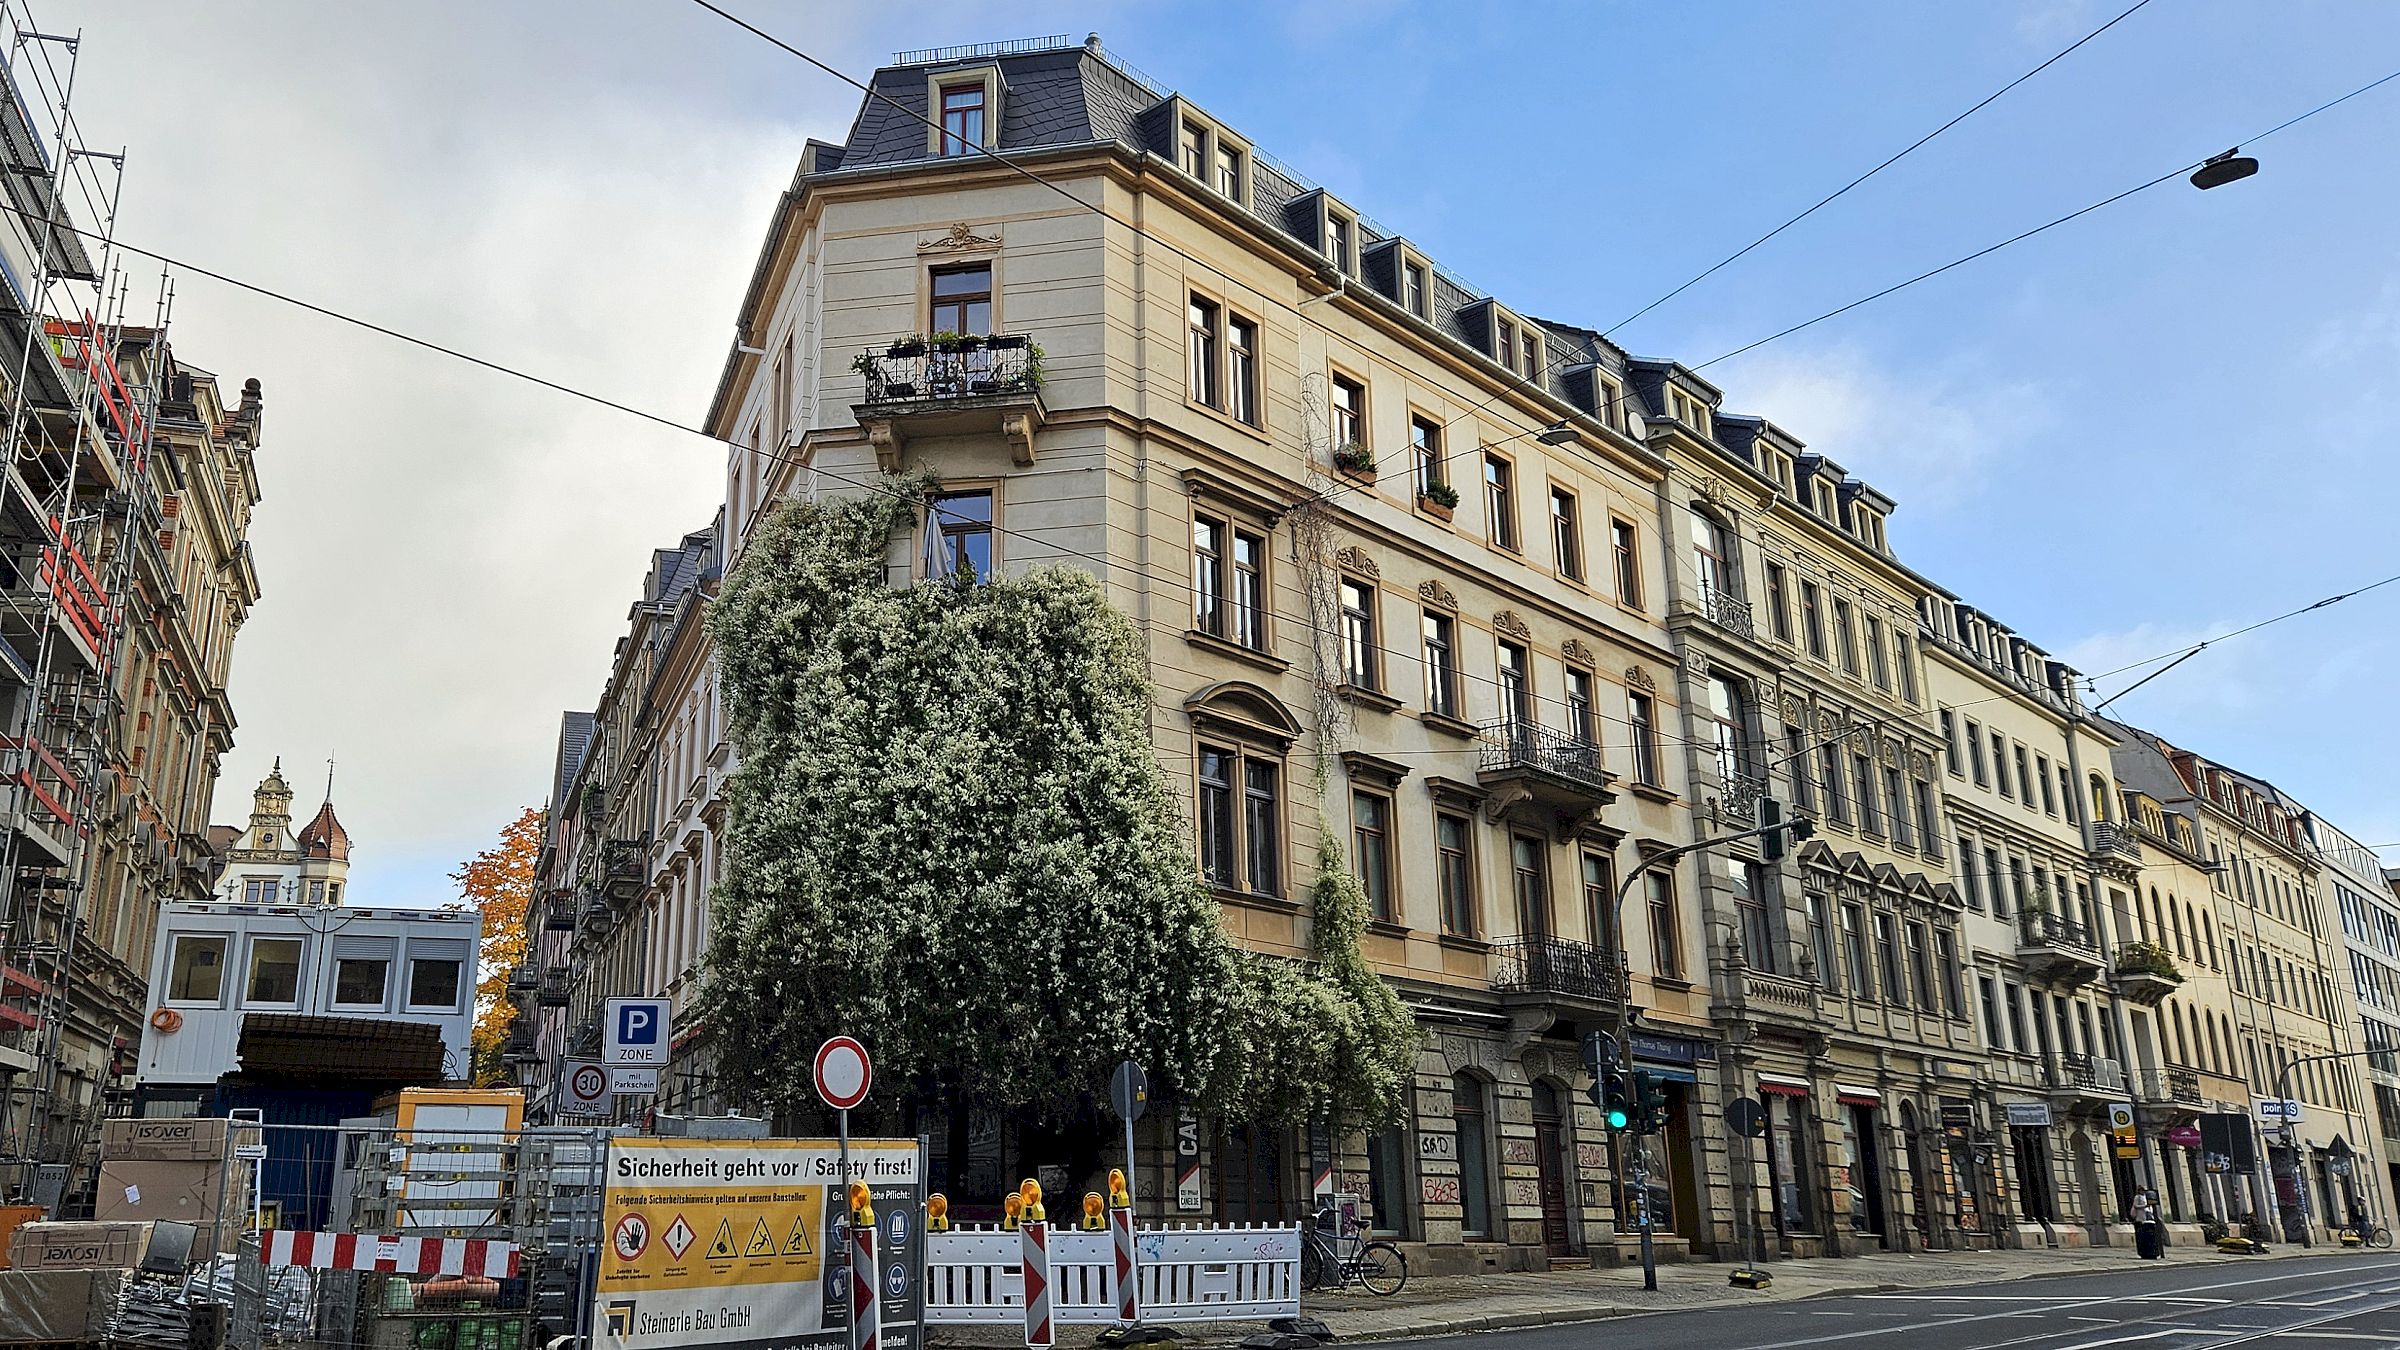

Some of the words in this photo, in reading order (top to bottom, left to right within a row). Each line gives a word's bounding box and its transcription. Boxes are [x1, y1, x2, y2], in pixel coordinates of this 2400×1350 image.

[627, 1010, 649, 1040] P
[620, 1049, 653, 1060] ZONE
[578, 1074, 599, 1091] 30
[614, 1081, 654, 1089] Parkschein
[573, 1101, 600, 1112] ZONE
[2263, 1104, 2288, 1114] poin
[617, 1157, 718, 1177] Sicherheit
[724, 1157, 765, 1181] geht
[771, 1162, 799, 1177] vor
[873, 1157, 912, 1175] first!
[616, 1194, 647, 1206] Folgende
[649, 1193, 714, 1205] Sicherheitshinweise
[715, 1194, 736, 1205] gelten
[737, 1193, 748, 1203] auf
[886, 1191, 911, 1200] Pflicht:
[639, 1310, 691, 1335] Steinerle
[695, 1309, 716, 1330] Bau
[720, 1305, 751, 1328] GmbH
[880, 1335, 908, 1348] melden!
